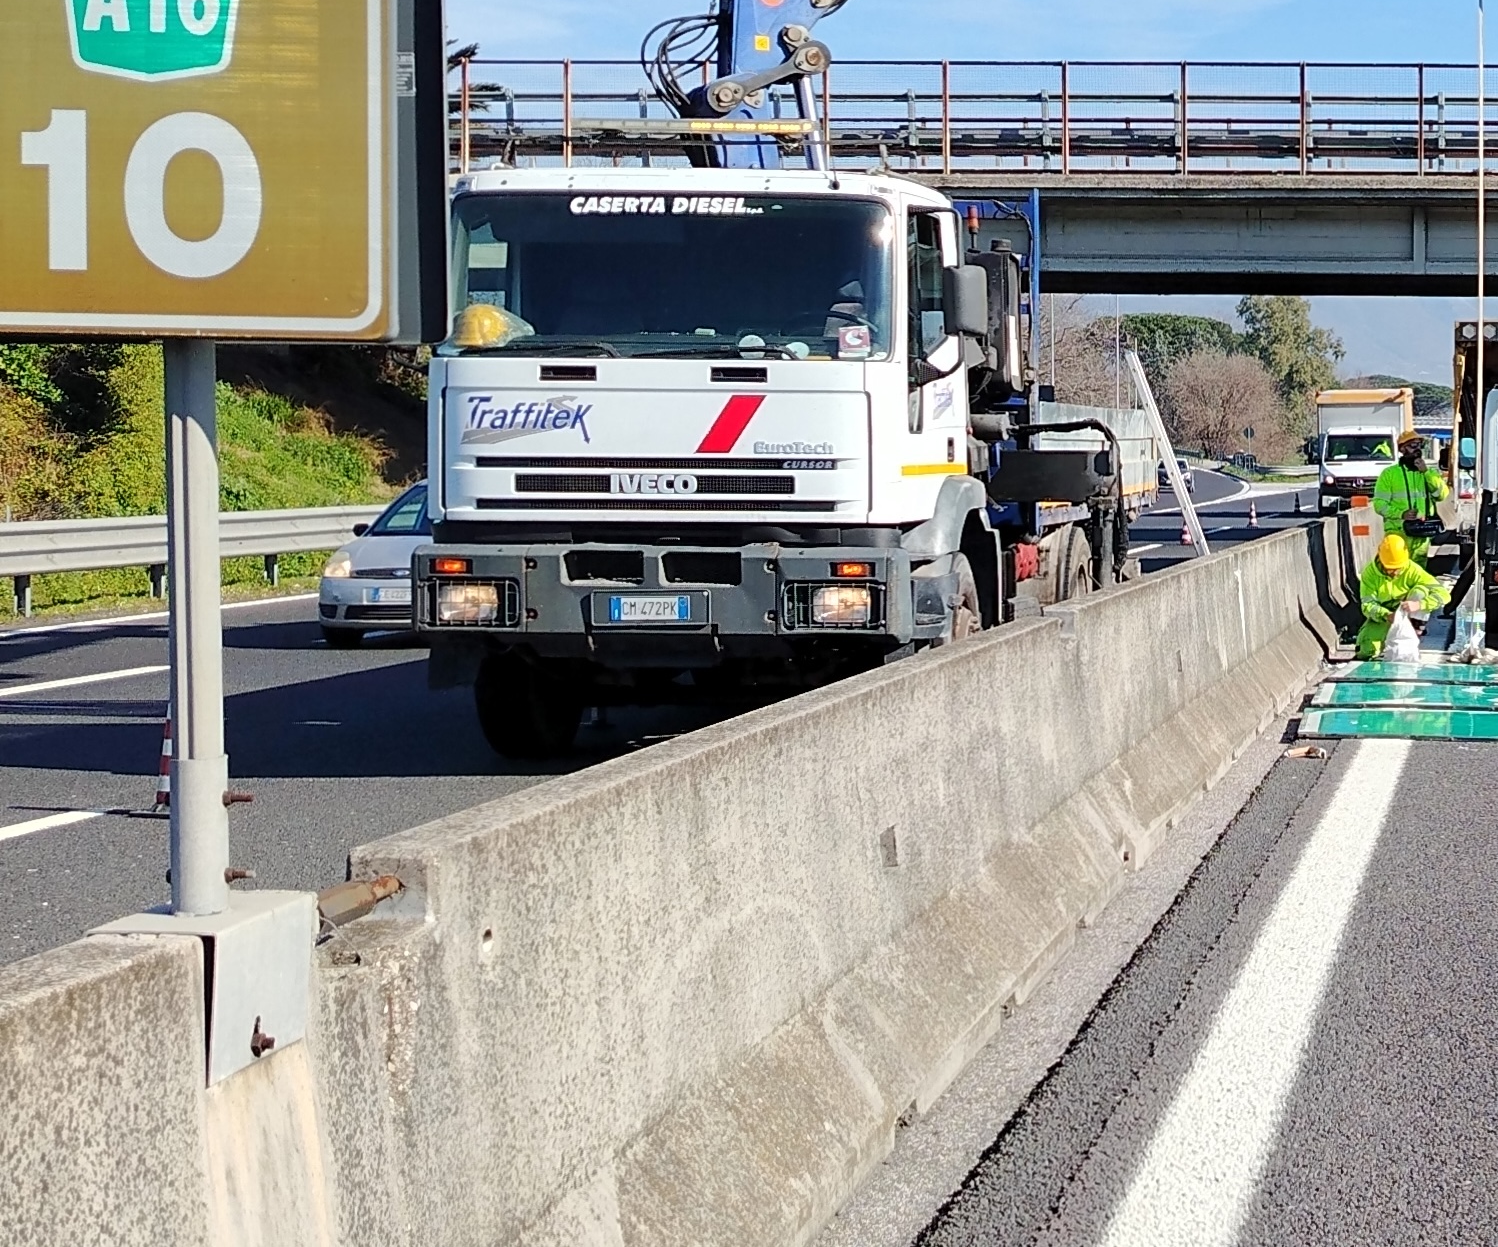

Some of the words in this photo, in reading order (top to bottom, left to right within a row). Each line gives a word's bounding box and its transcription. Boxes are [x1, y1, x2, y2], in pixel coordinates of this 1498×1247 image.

[20, 108, 263, 279] 10
[569, 196, 666, 214] CASERTA
[671, 197, 746, 214] DIESEL
[753, 441, 834, 454] EuroTech
[782, 460, 833, 469] CURSOR
[610, 473, 698, 494] IVECO
